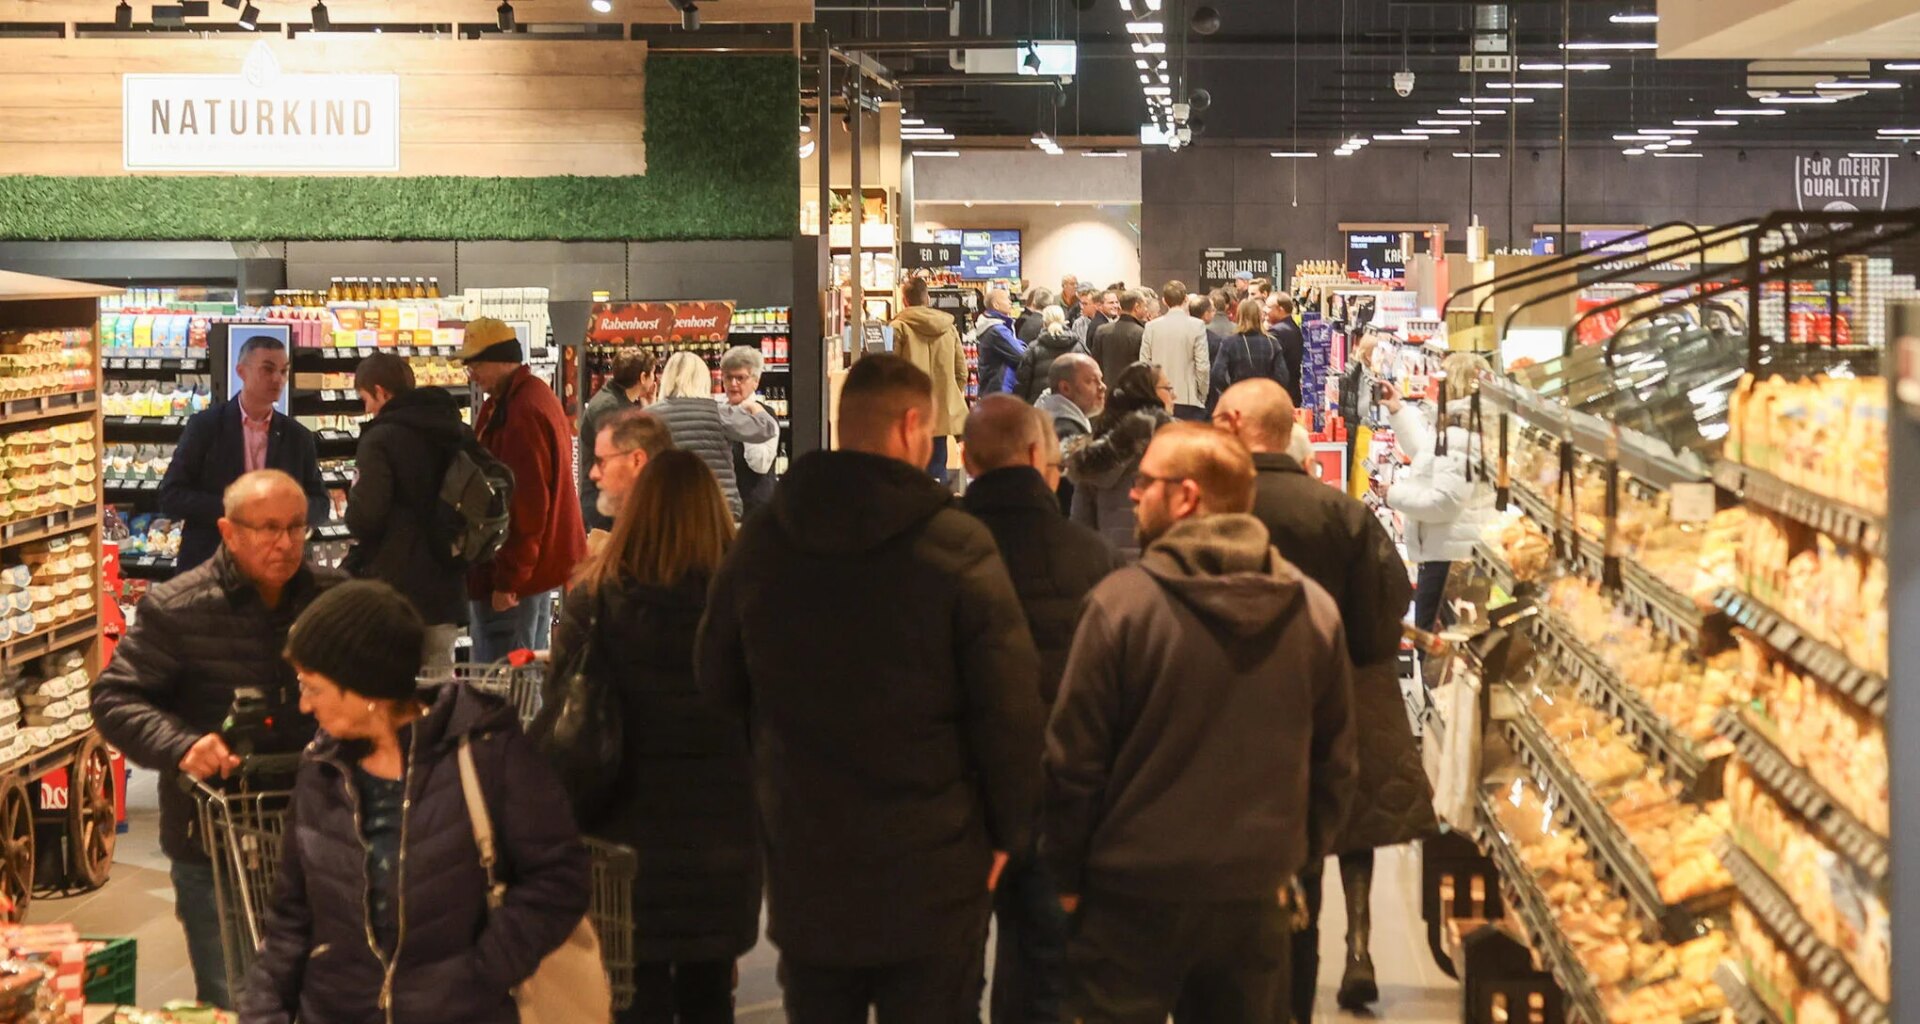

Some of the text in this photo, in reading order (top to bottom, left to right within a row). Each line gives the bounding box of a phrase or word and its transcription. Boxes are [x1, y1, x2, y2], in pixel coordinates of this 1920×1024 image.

[152, 98, 372, 136] NATURKIND
[1838, 158, 1881, 176] MEHR
[1804, 176, 1880, 197] QUALITÄT
[1206, 259, 1267, 272] SPEZIALITÄTEN
[601, 317, 660, 331] Rabenhorst
